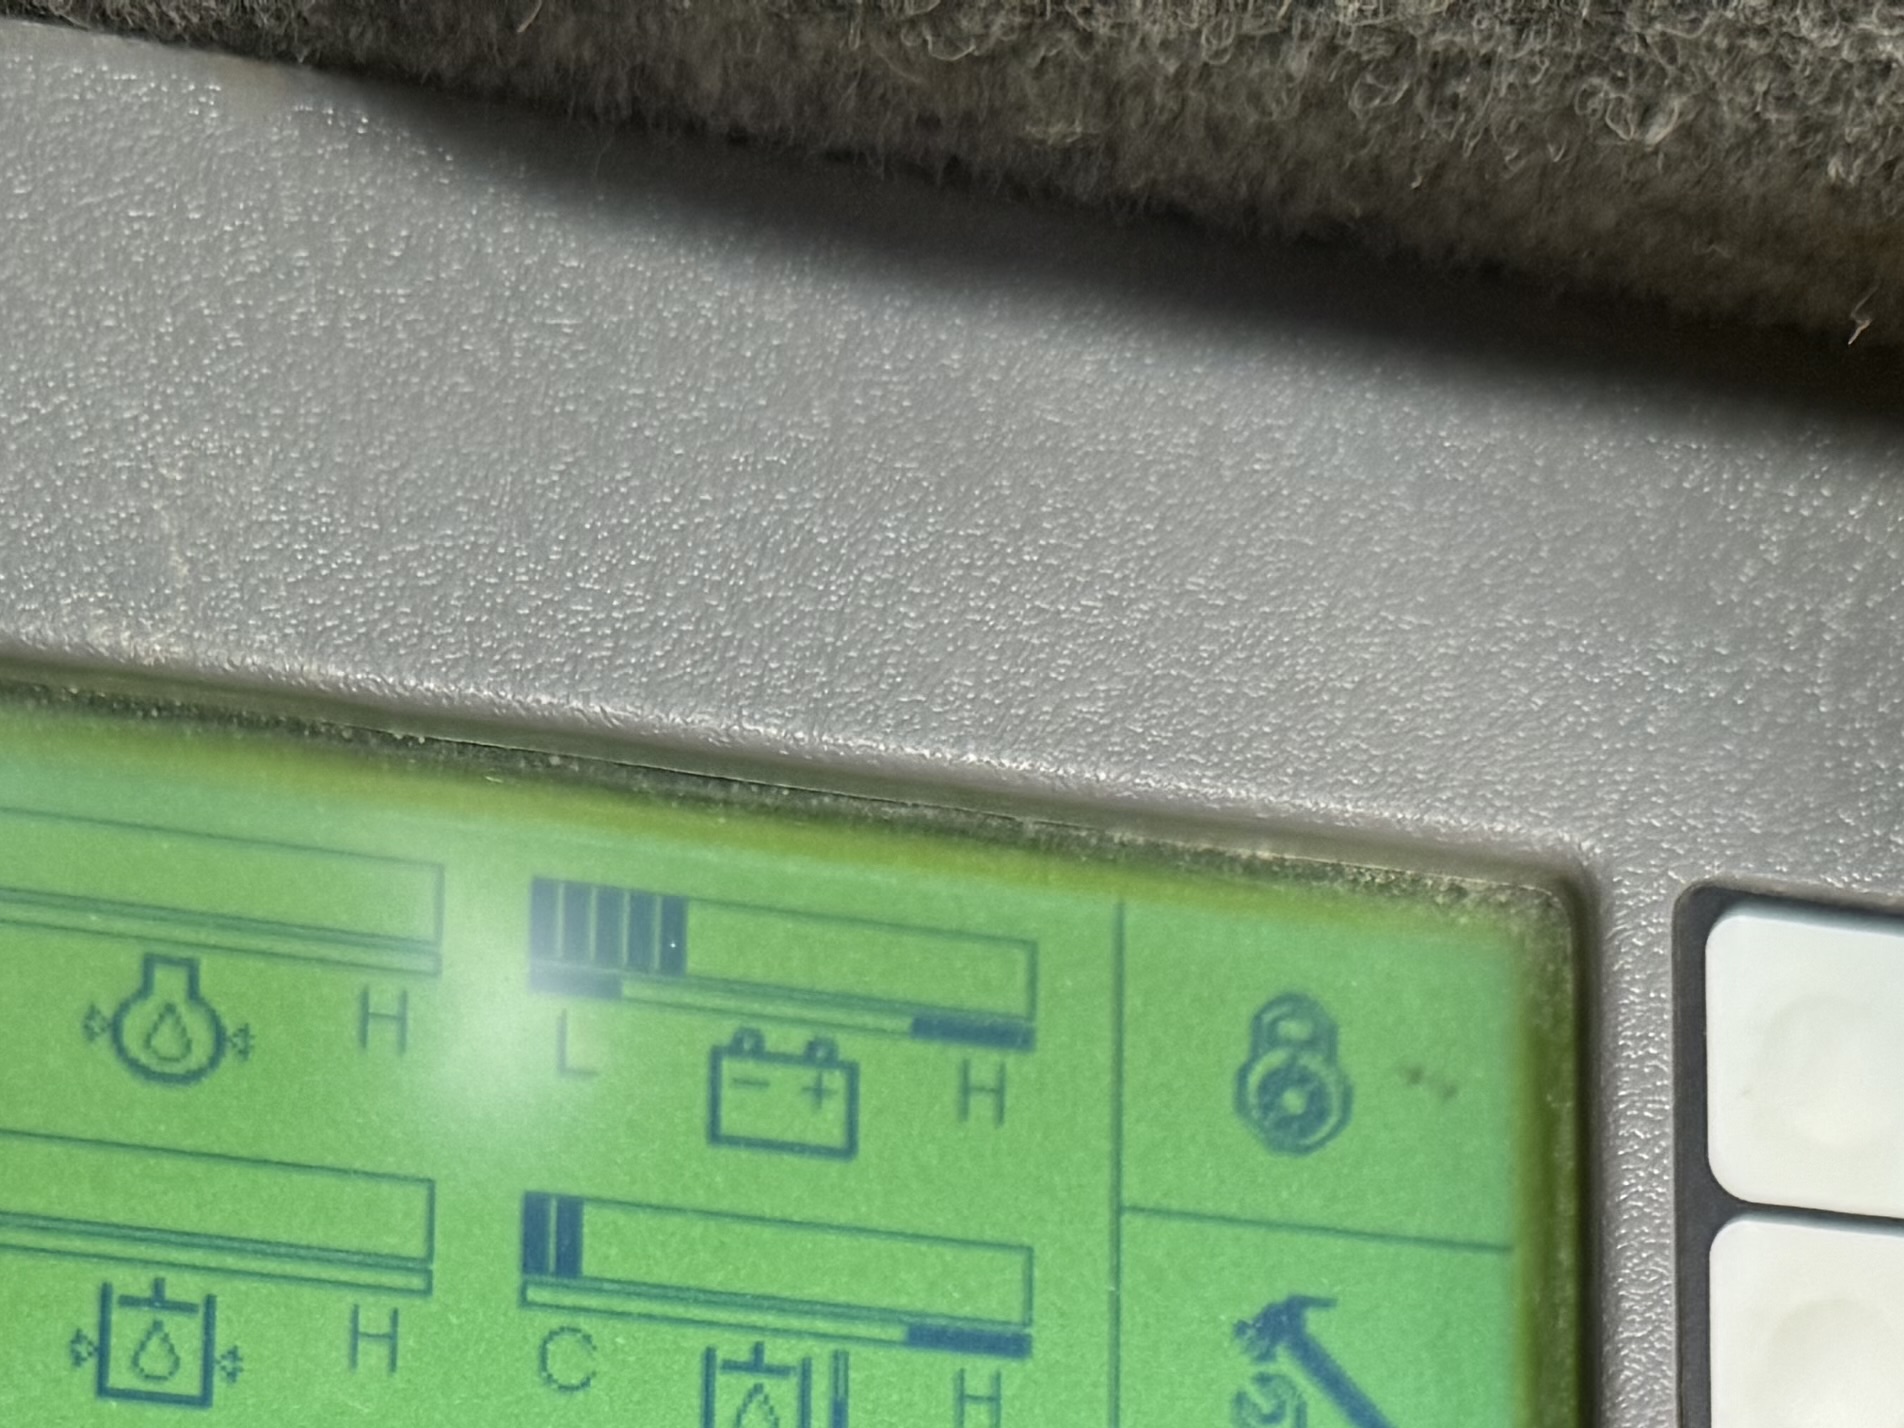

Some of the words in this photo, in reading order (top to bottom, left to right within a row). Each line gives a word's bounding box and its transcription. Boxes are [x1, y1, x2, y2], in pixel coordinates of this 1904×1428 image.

[360, 984, 407, 1054] H
[958, 1057, 1005, 1127] H
[349, 1303, 398, 1377] H
[539, 1325, 596, 1393] C
